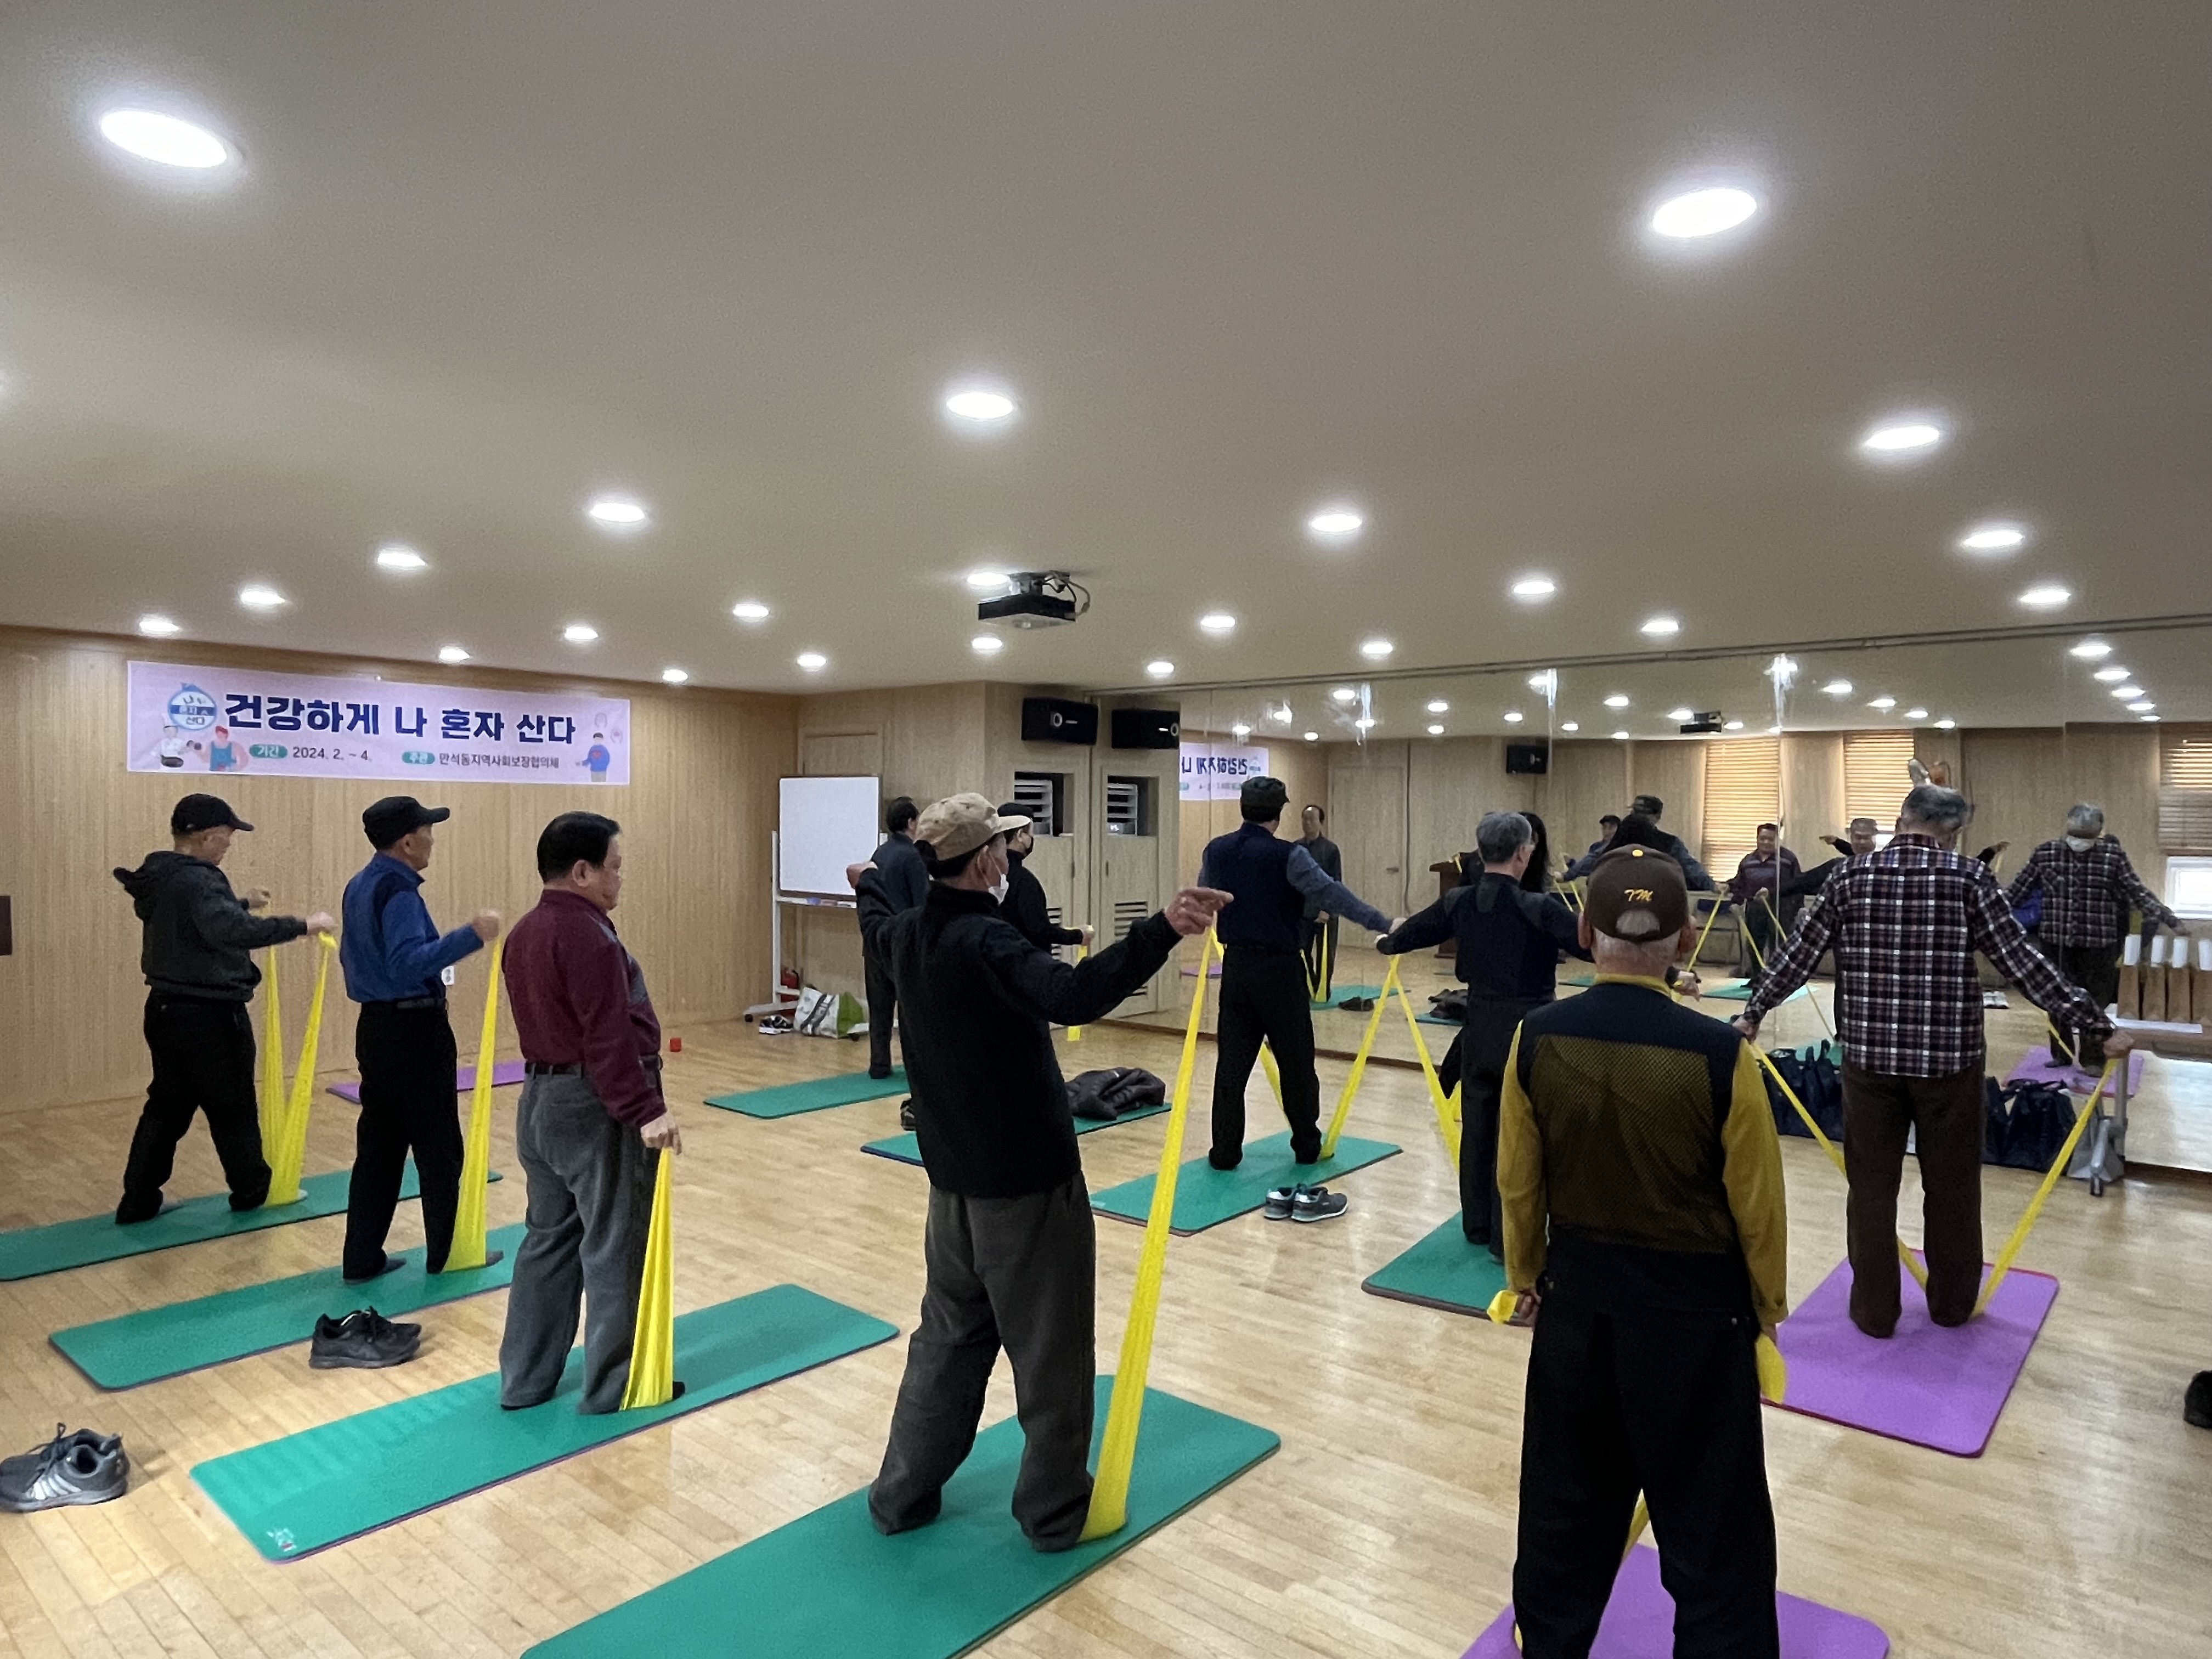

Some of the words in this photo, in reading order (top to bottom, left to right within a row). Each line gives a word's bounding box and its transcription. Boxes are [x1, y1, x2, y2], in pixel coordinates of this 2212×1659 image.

[225, 693, 380, 735] 건강하게
[395, 706, 427, 737] 나
[441, 709, 505, 741] 혼자
[516, 714, 576, 744] 산다
[257, 744, 279, 758] 기간
[293, 746, 329, 760] 2024.
